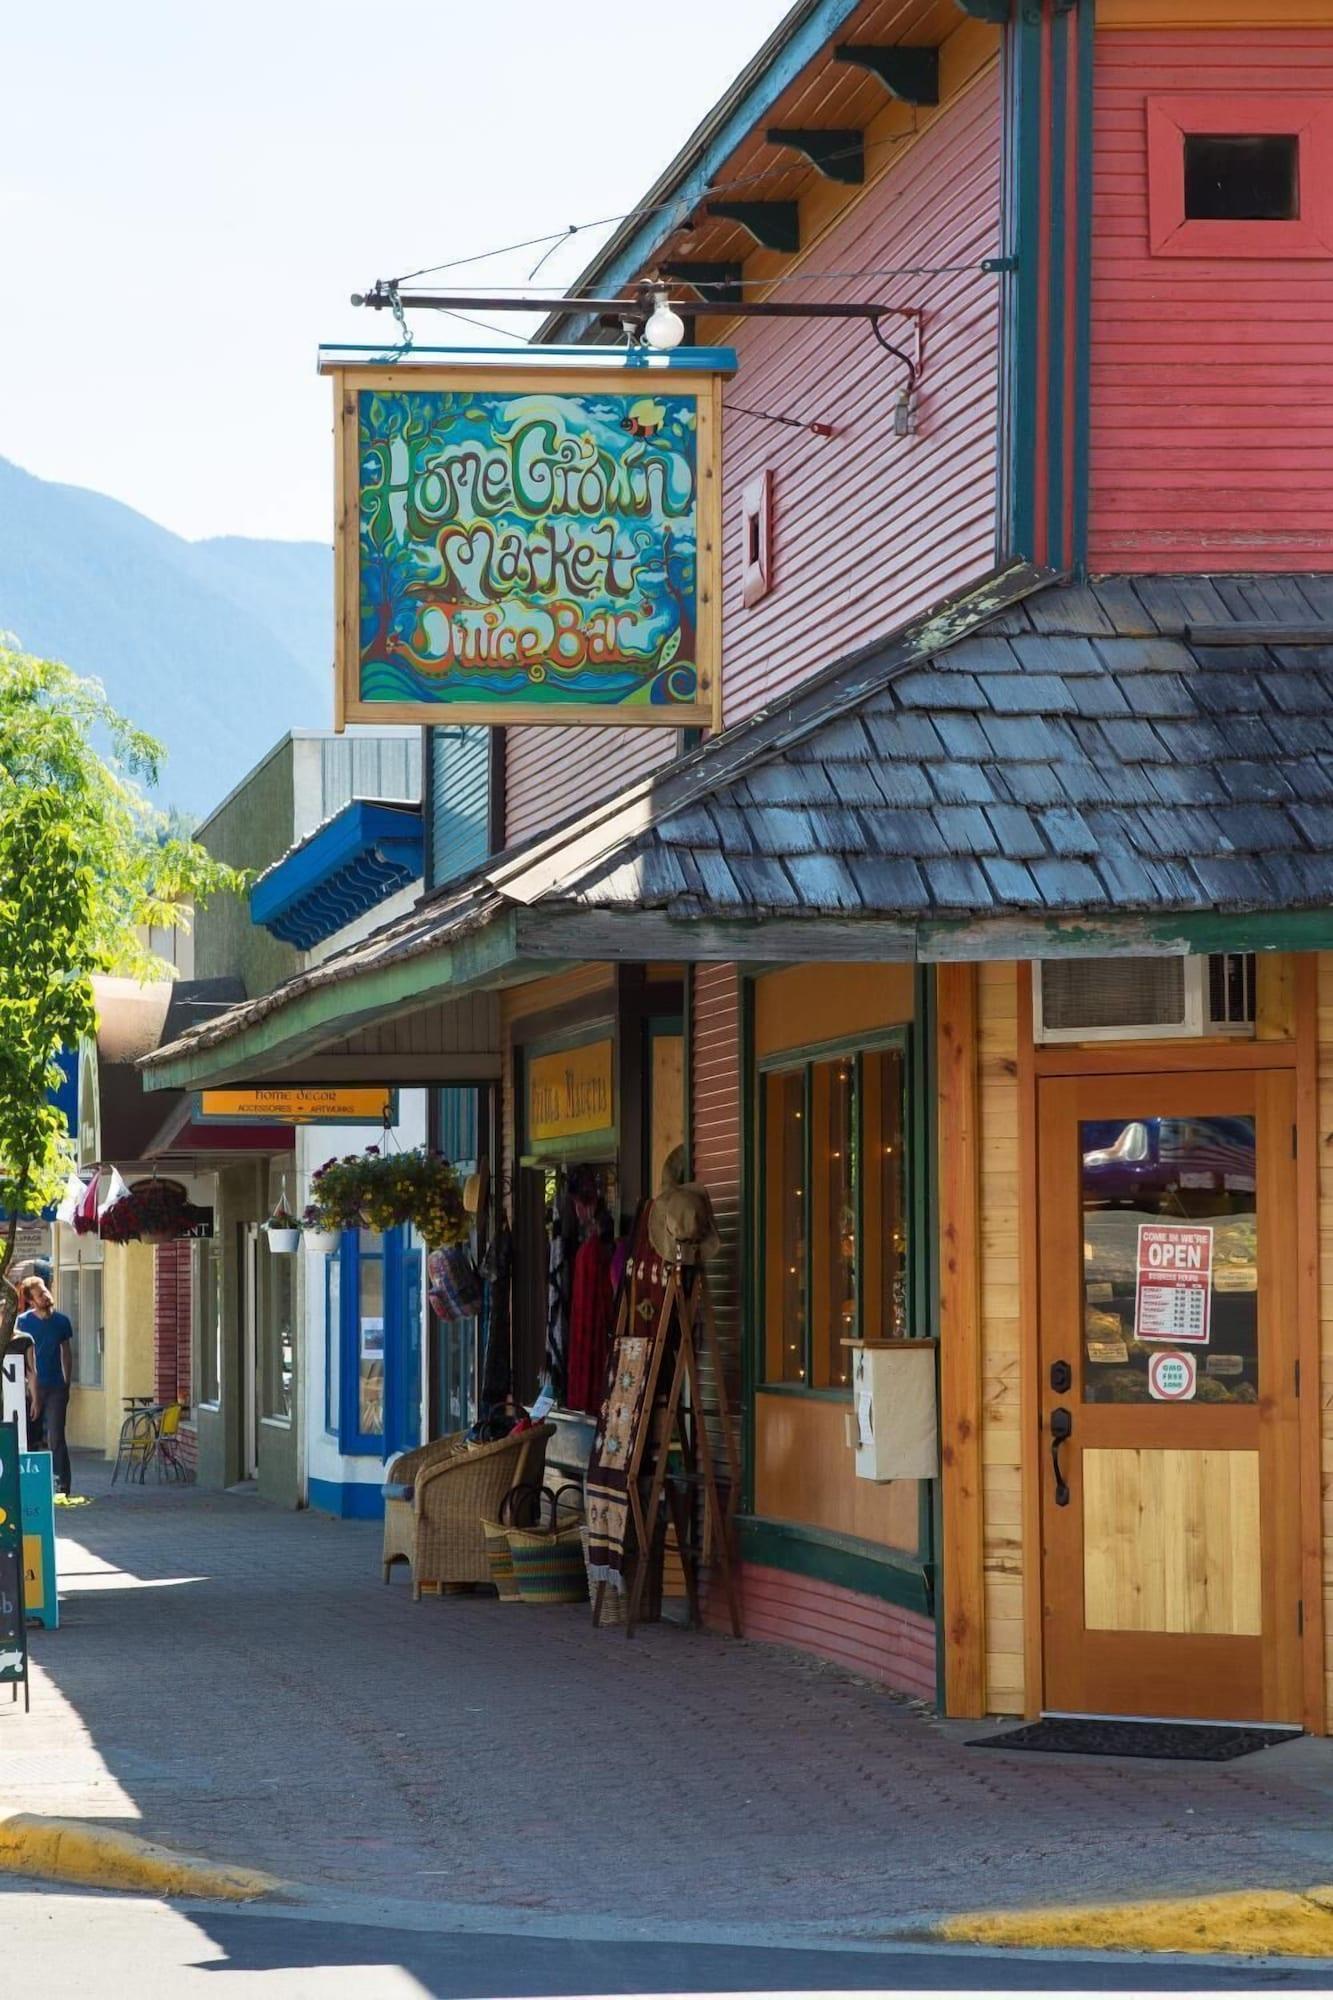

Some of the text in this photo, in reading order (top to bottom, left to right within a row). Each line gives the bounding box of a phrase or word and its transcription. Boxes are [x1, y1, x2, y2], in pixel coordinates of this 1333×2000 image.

[420, 518, 640, 602] Market
[412, 603, 650, 670] Juice Bar
[1143, 1232, 1167, 1242] COME
[1180, 1233, 1208, 1244] WE'RE
[1148, 1243, 1201, 1269] OPEN
